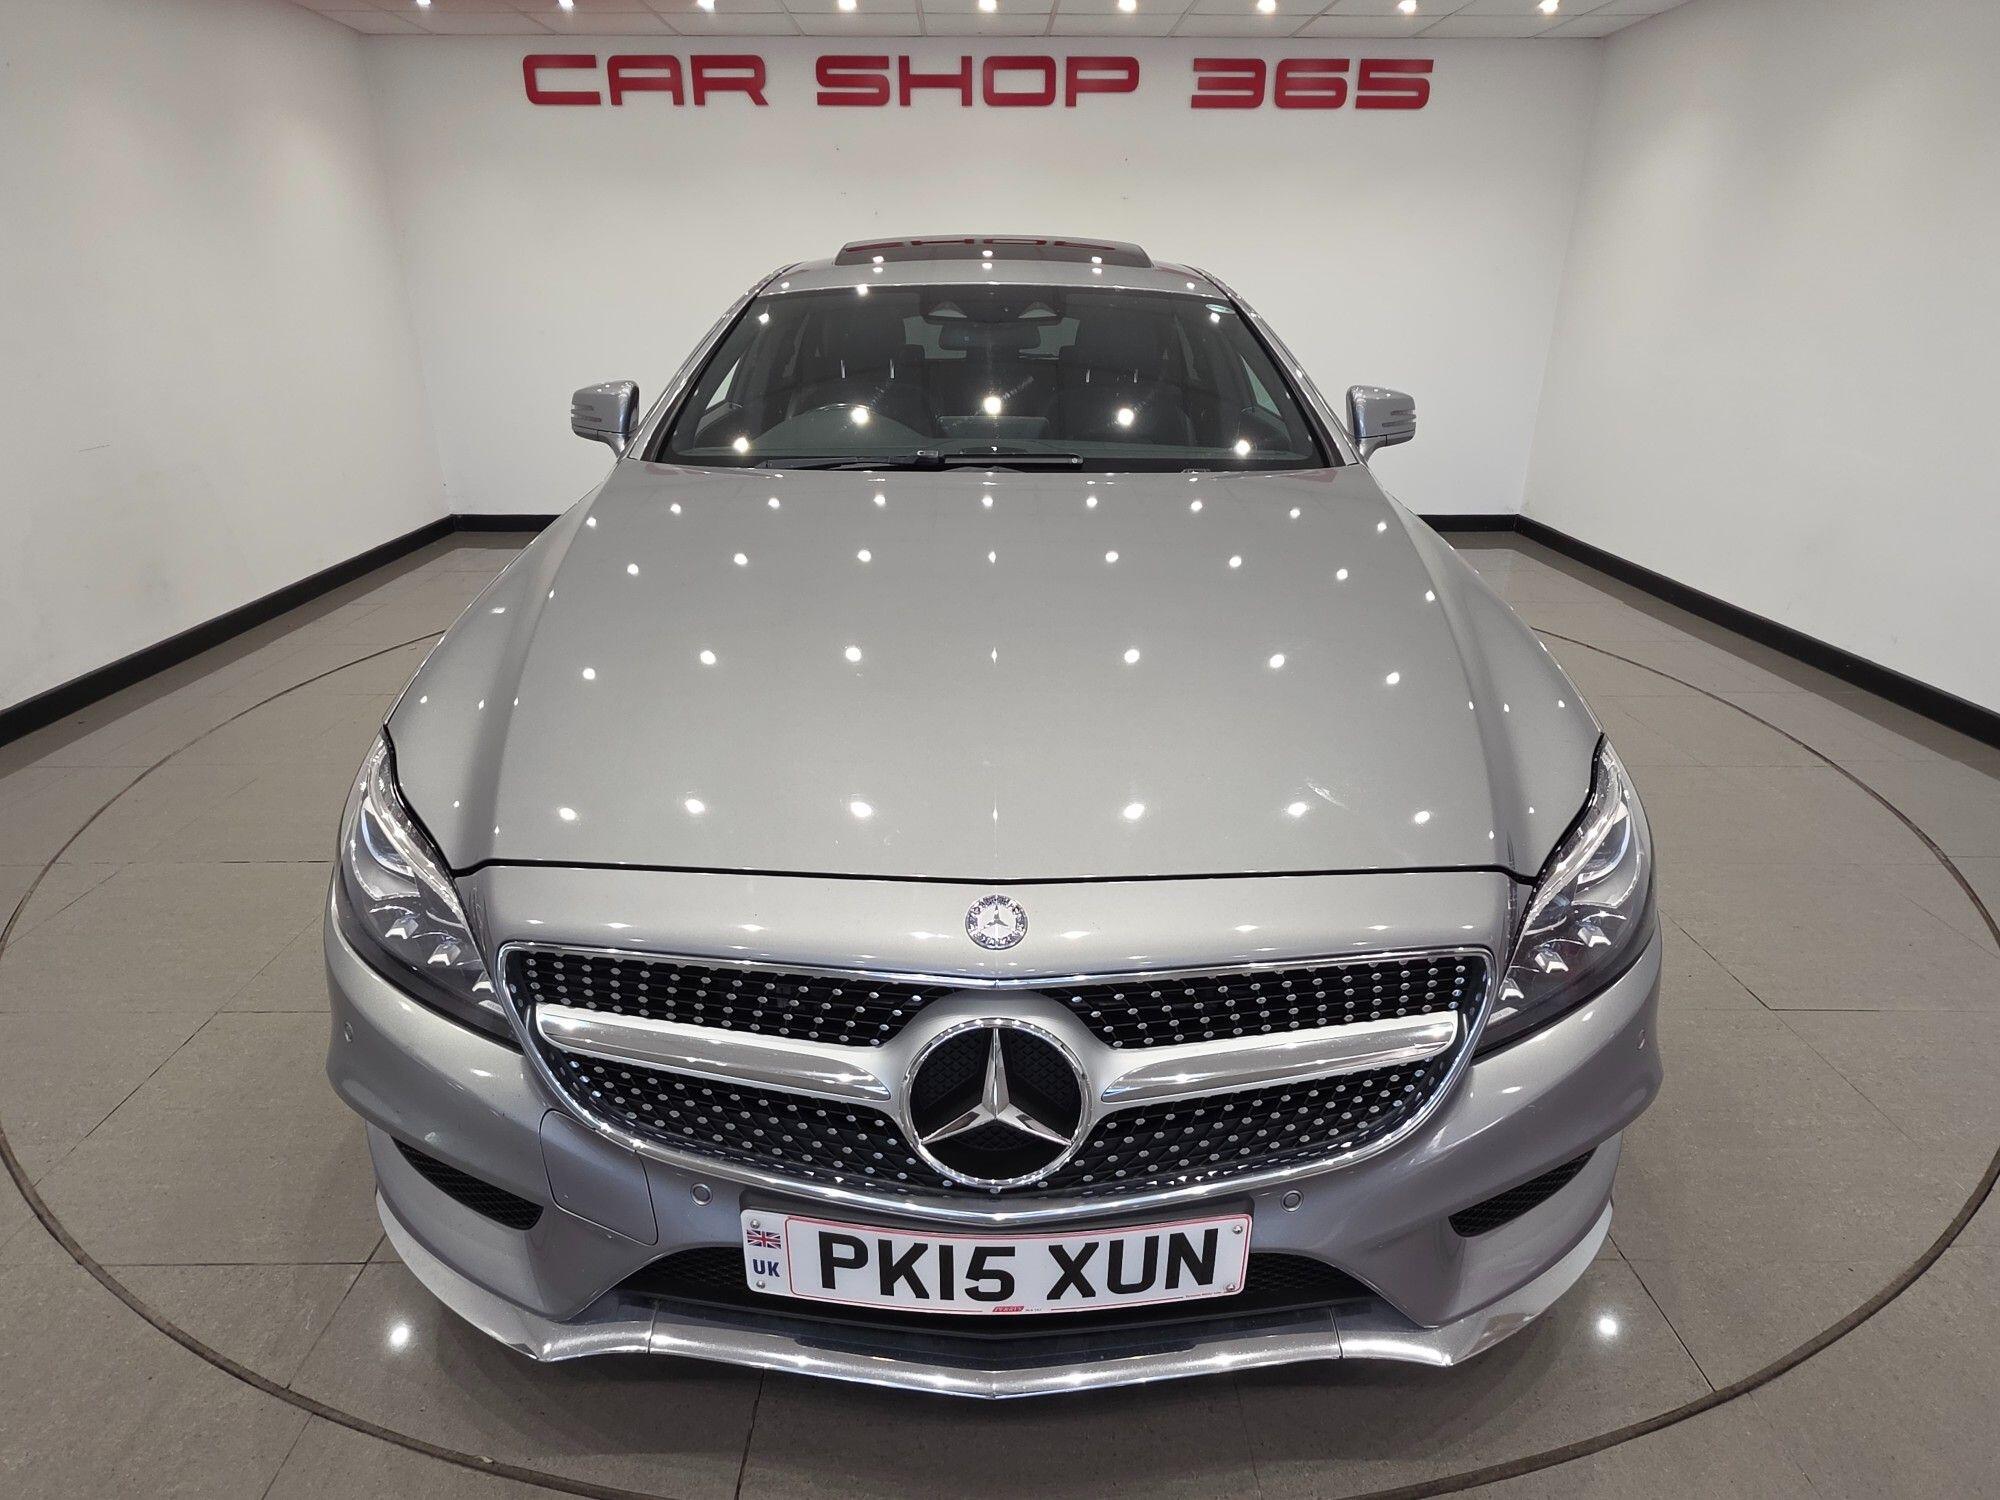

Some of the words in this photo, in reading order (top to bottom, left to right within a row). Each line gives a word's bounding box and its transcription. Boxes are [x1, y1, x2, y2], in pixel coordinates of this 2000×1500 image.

[522, 54, 769, 107] CAR
[815, 55, 1140, 108] SHOP
[1191, 58, 1433, 110] 365
[752, 1258, 781, 1278] UK
[818, 1230, 1016, 1302] PK15
[1046, 1227, 1219, 1301] XUN
